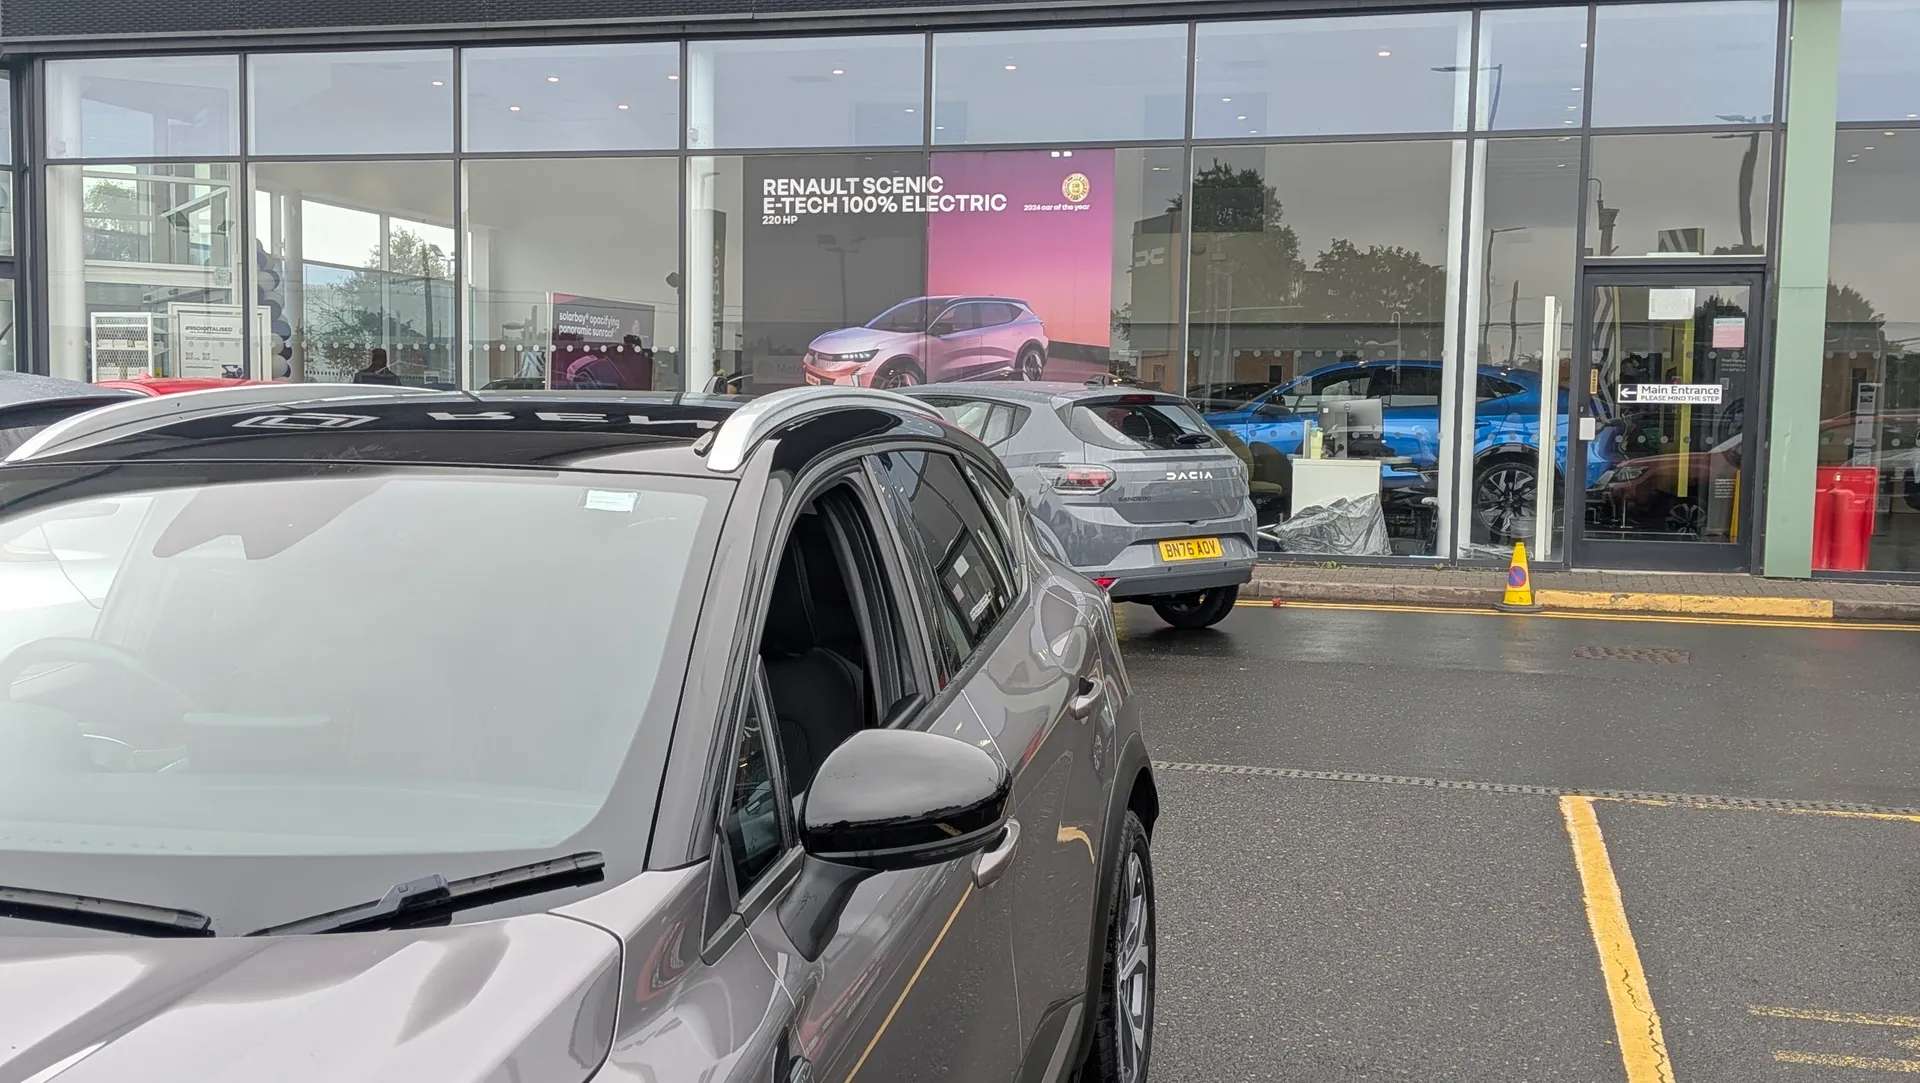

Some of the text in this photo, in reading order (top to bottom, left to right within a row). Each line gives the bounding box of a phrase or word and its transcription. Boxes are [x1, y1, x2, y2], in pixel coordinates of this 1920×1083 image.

[763, 176, 944, 196] RENAULT SCENIC
[763, 194, 1007, 214] E-TECH 100% ELECTRIC
[1062, 203, 1073, 211] the
[1074, 204, 1090, 212] year
[762, 215, 798, 225] 220 HP
[559, 324, 591, 336] panoramic
[1641, 385, 1720, 395] Main Entrance
[1166, 471, 1213, 480] DACIA
[1165, 542, 1195, 558] BN76
